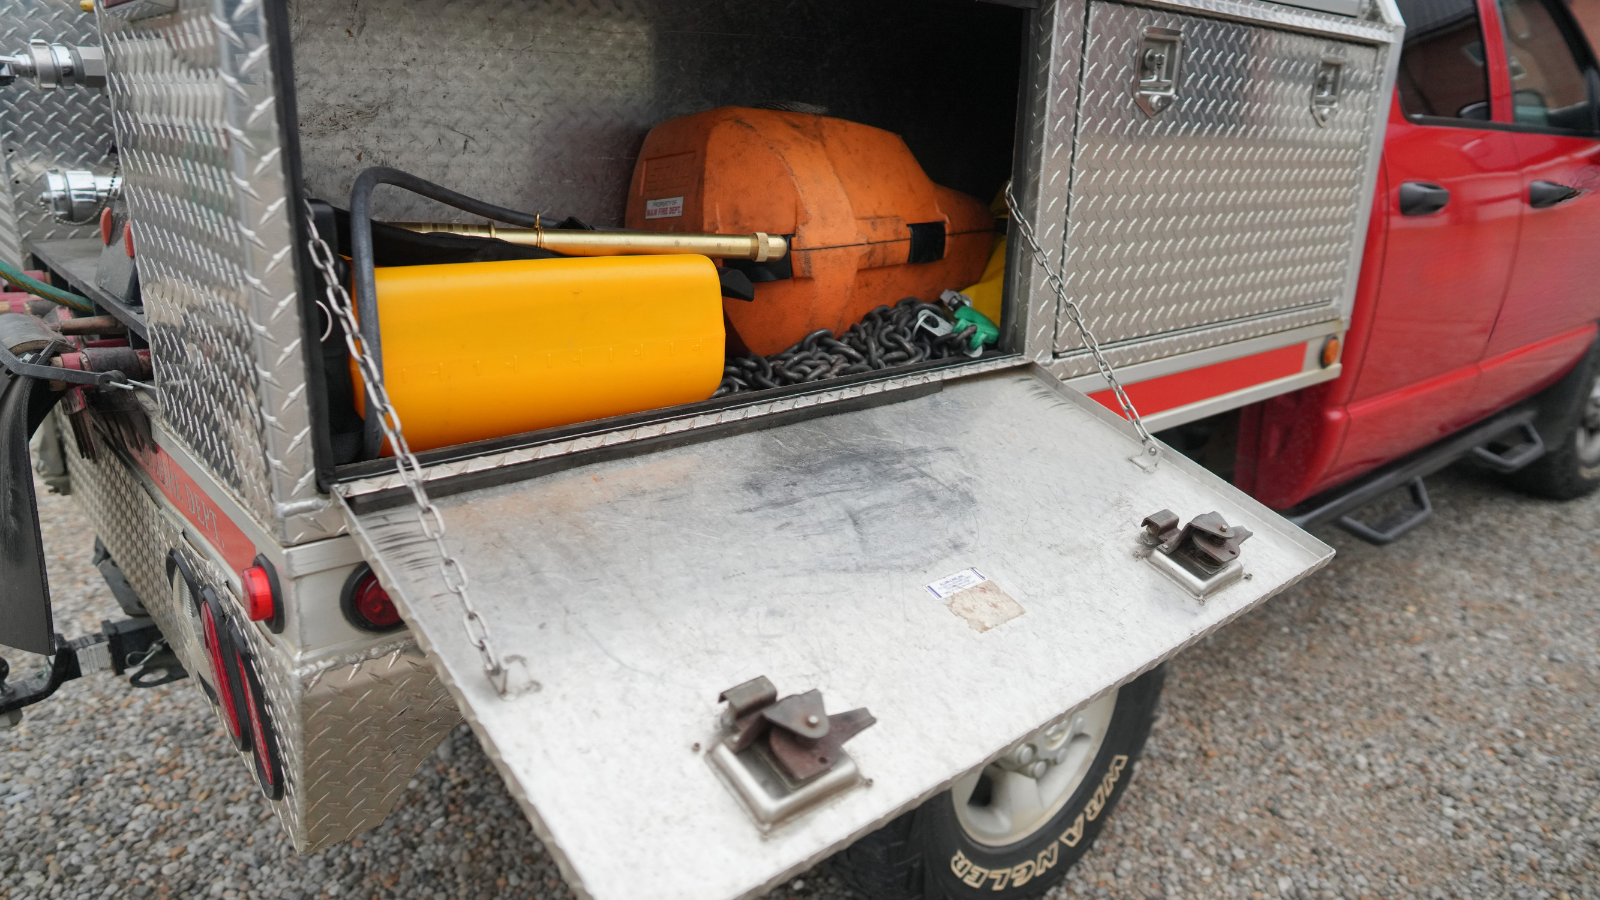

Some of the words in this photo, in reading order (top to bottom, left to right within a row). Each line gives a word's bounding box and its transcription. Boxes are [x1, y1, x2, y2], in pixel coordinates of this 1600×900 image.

[658, 207, 669, 216] FIRE
[669, 205, 681, 215] DEPT.
[950, 755, 1128, 891] WRANGLER
